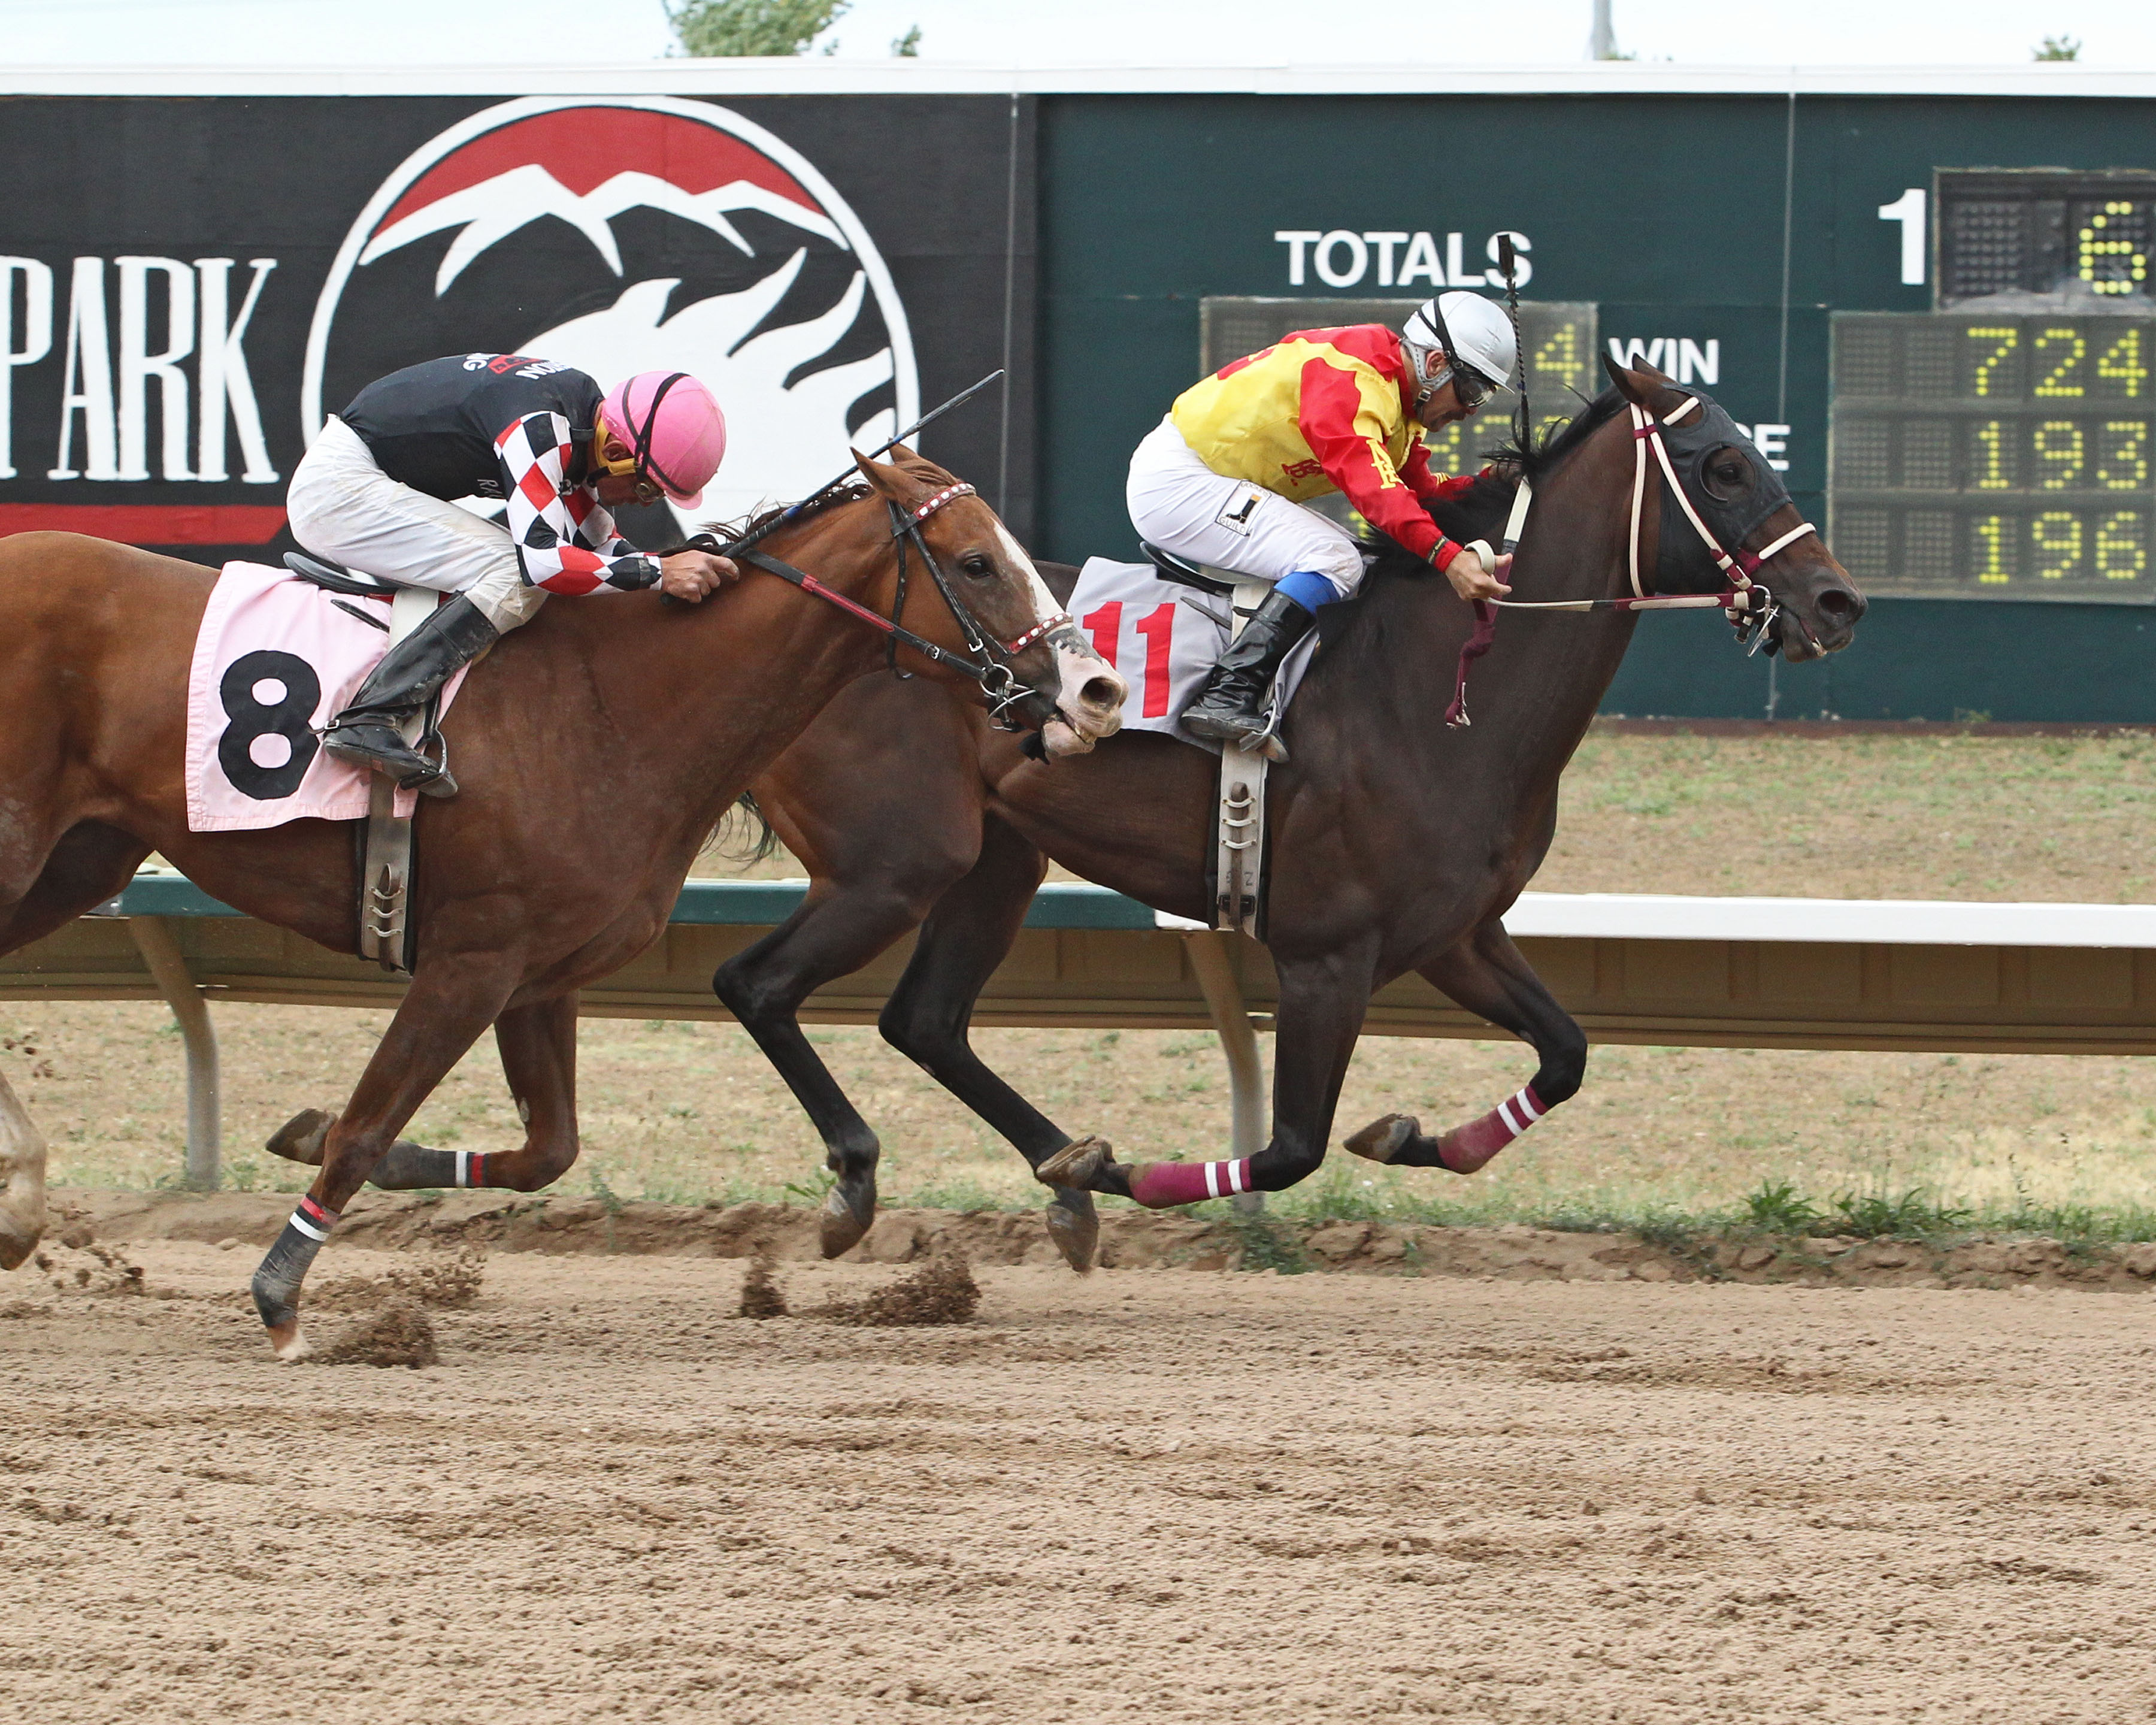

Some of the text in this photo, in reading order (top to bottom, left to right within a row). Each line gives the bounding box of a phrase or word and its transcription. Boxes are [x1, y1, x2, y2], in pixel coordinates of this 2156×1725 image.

[1274, 229, 1533, 289] TOTALS
[1879, 188, 1926, 285] 1
[2079, 201, 2146, 294] 6
[0, 256, 280, 483] PARK
[1535, 324, 1583, 389] 4
[1608, 337, 1719, 385] WIN
[1967, 328, 2148, 397] 724
[1979, 422, 2147, 489] 193
[1218, 516, 1246, 534] GUILD
[1978, 512, 2146, 583] 196
[1082, 601, 1176, 718] 11
[218, 650, 322, 800] 8
